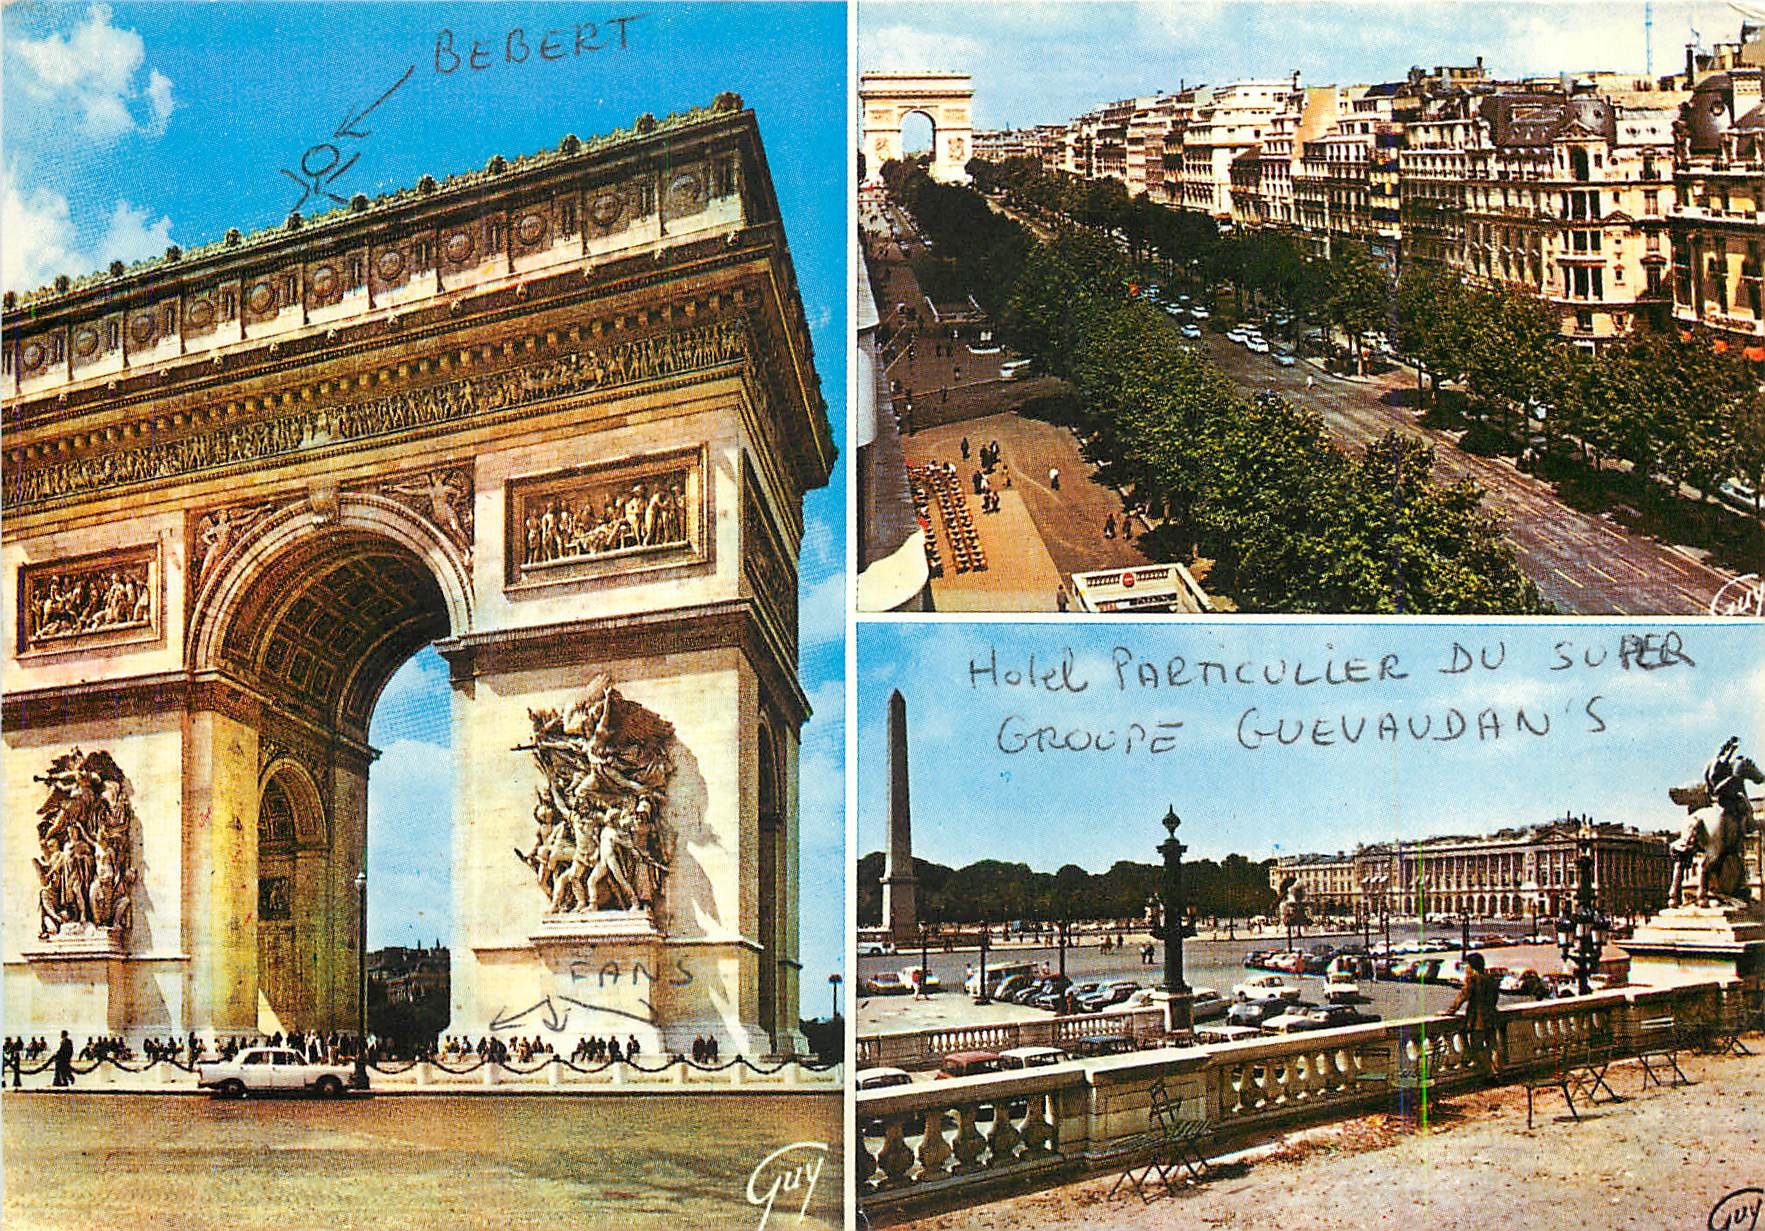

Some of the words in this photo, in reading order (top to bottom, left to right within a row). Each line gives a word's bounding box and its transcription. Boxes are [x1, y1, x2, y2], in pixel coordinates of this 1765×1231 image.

[435, 12, 650, 73] BEBERT
[1438, 641, 1506, 674] DU
[1549, 631, 1697, 671] SUPER
[996, 714, 1184, 754] GROUPE
[569, 959, 694, 988] FANS
